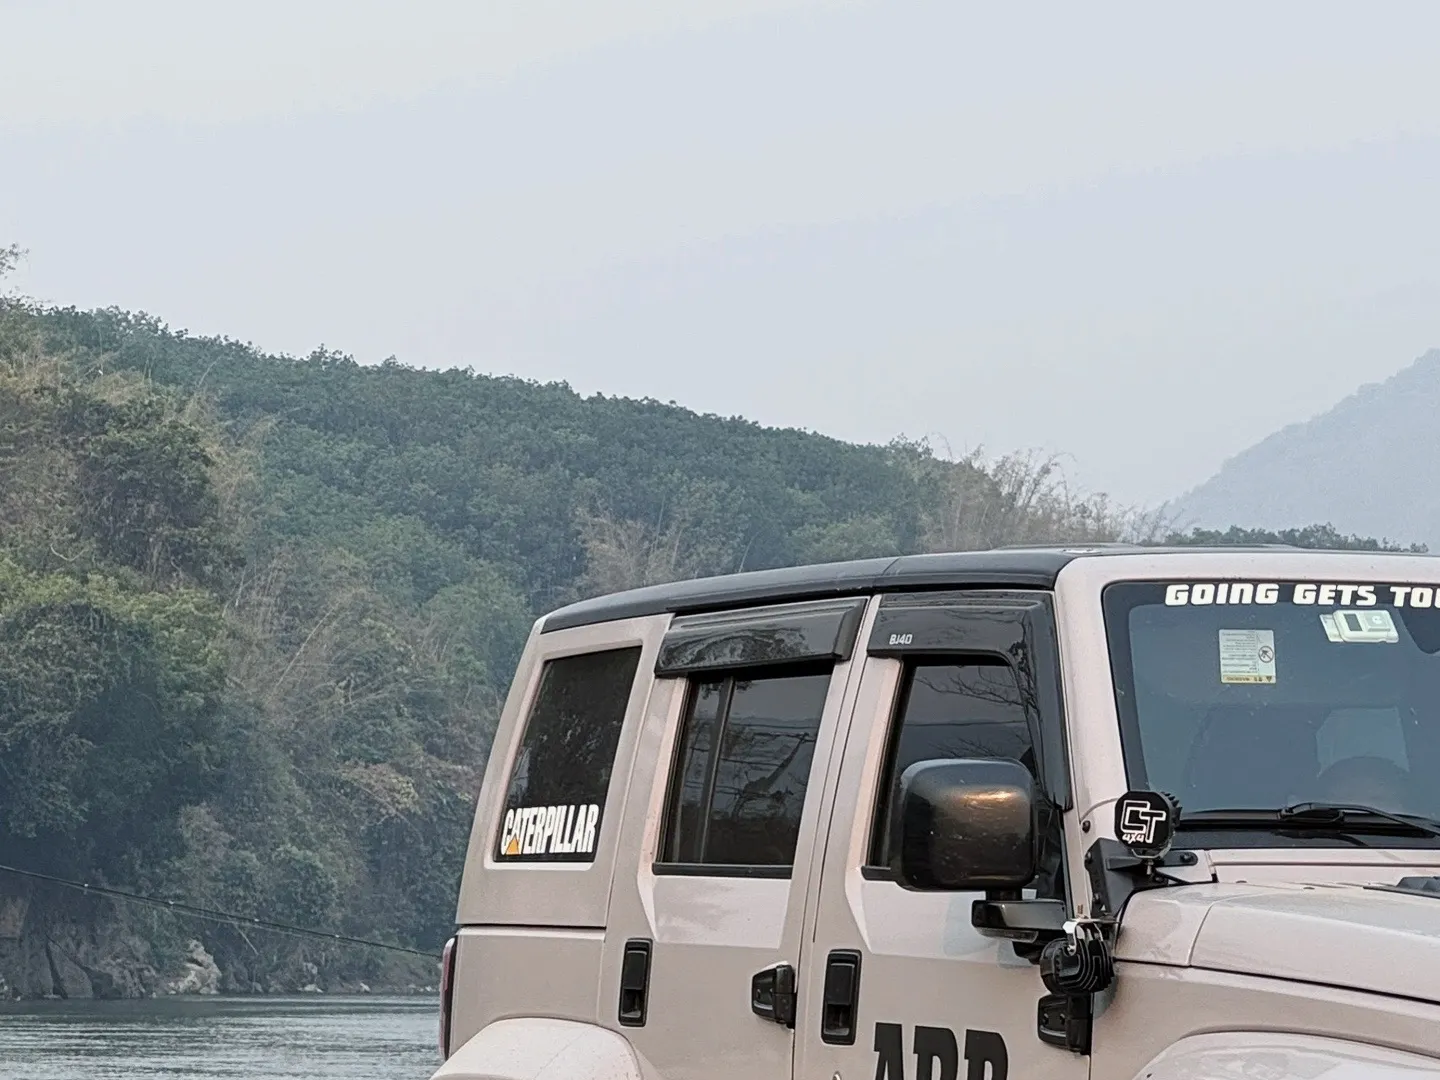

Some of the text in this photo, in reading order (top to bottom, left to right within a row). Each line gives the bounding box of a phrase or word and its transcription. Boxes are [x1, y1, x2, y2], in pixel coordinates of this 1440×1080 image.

[1164, 583, 1279, 606] GOING
[1292, 584, 1377, 606] GETS
[889, 633, 913, 645] BJ40
[501, 804, 599, 855] CATERPILLAR
